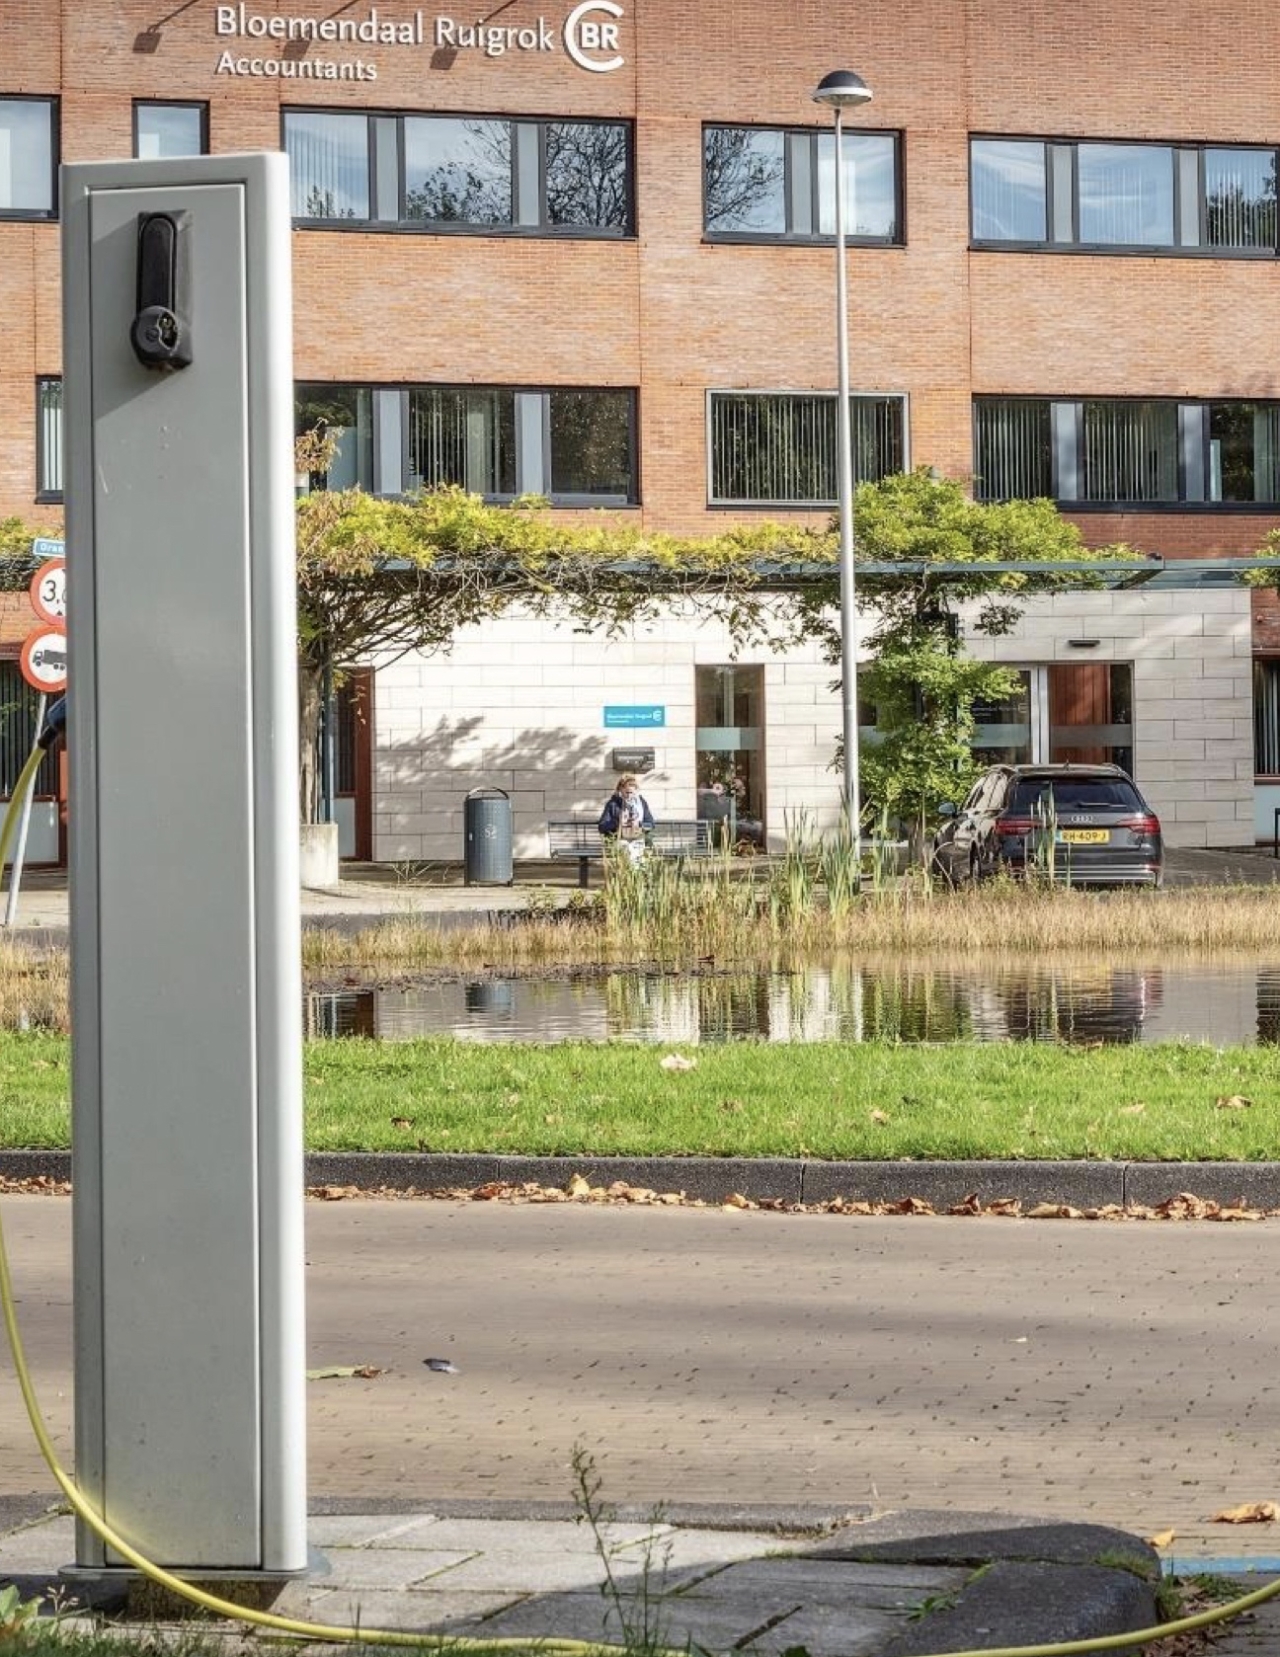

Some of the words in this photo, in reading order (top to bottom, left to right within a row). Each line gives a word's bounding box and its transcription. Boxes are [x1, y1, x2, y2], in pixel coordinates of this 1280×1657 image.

[216, 2, 423, 44] Bloemendaal
[436, 16, 555, 57] Ruigrok
[216, 50, 378, 80] Accountants
